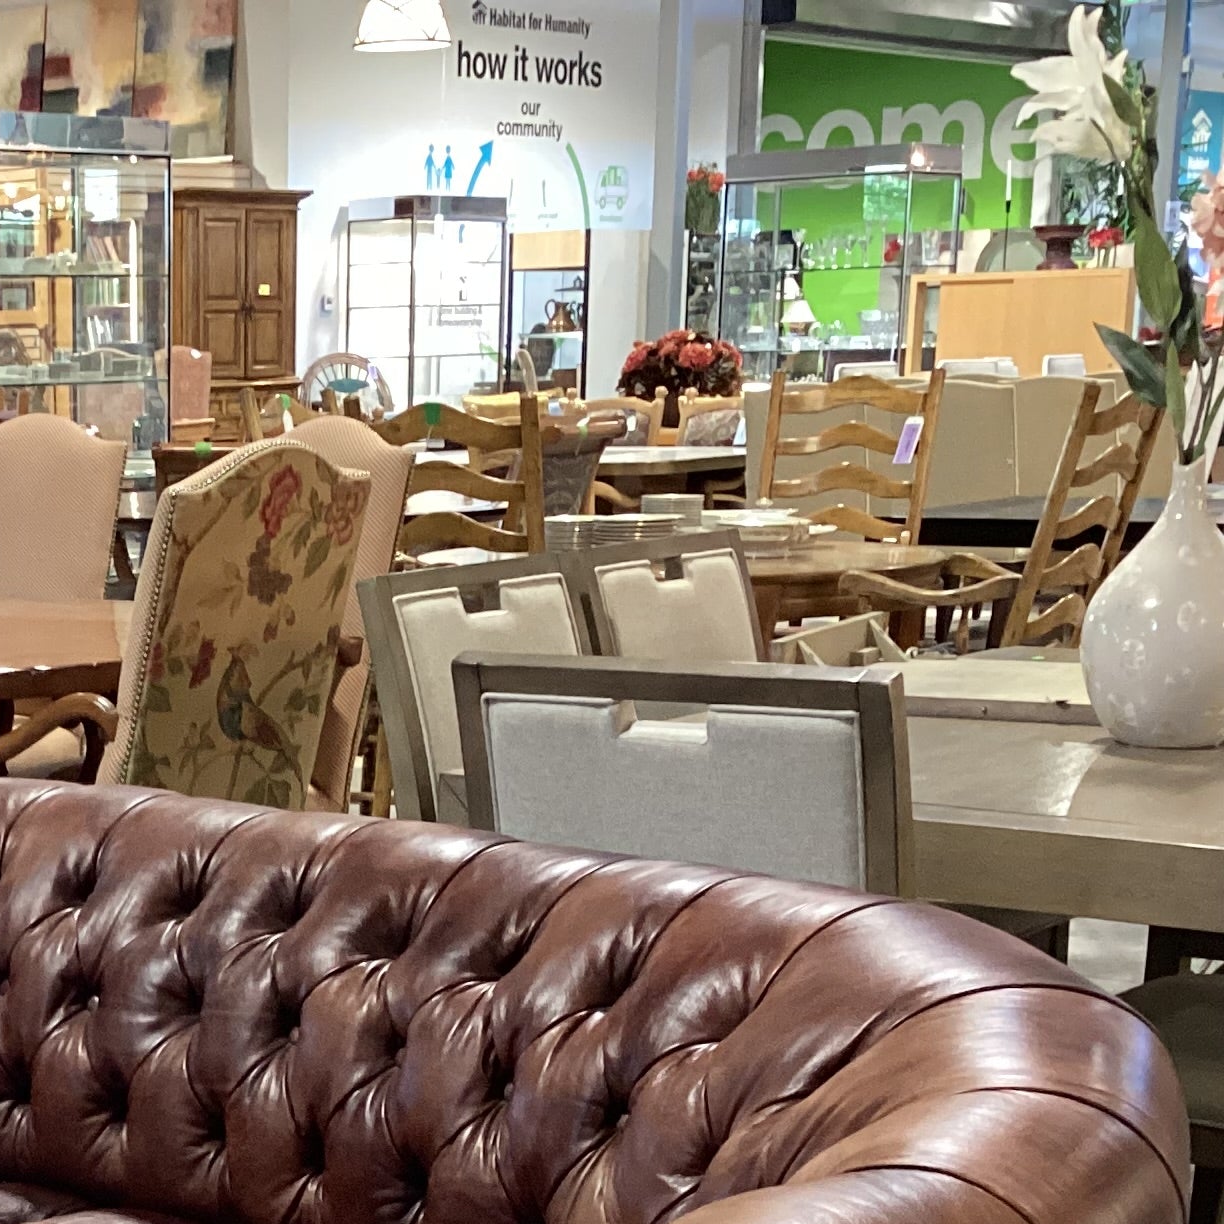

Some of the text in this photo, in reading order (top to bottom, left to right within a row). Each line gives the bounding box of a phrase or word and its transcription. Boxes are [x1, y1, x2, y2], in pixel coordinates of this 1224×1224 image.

[489, 8, 590, 40] Habitat for Humanity
[457, 40, 603, 88] how it works
[521, 101, 541, 116] our
[496, 119, 563, 142] community
